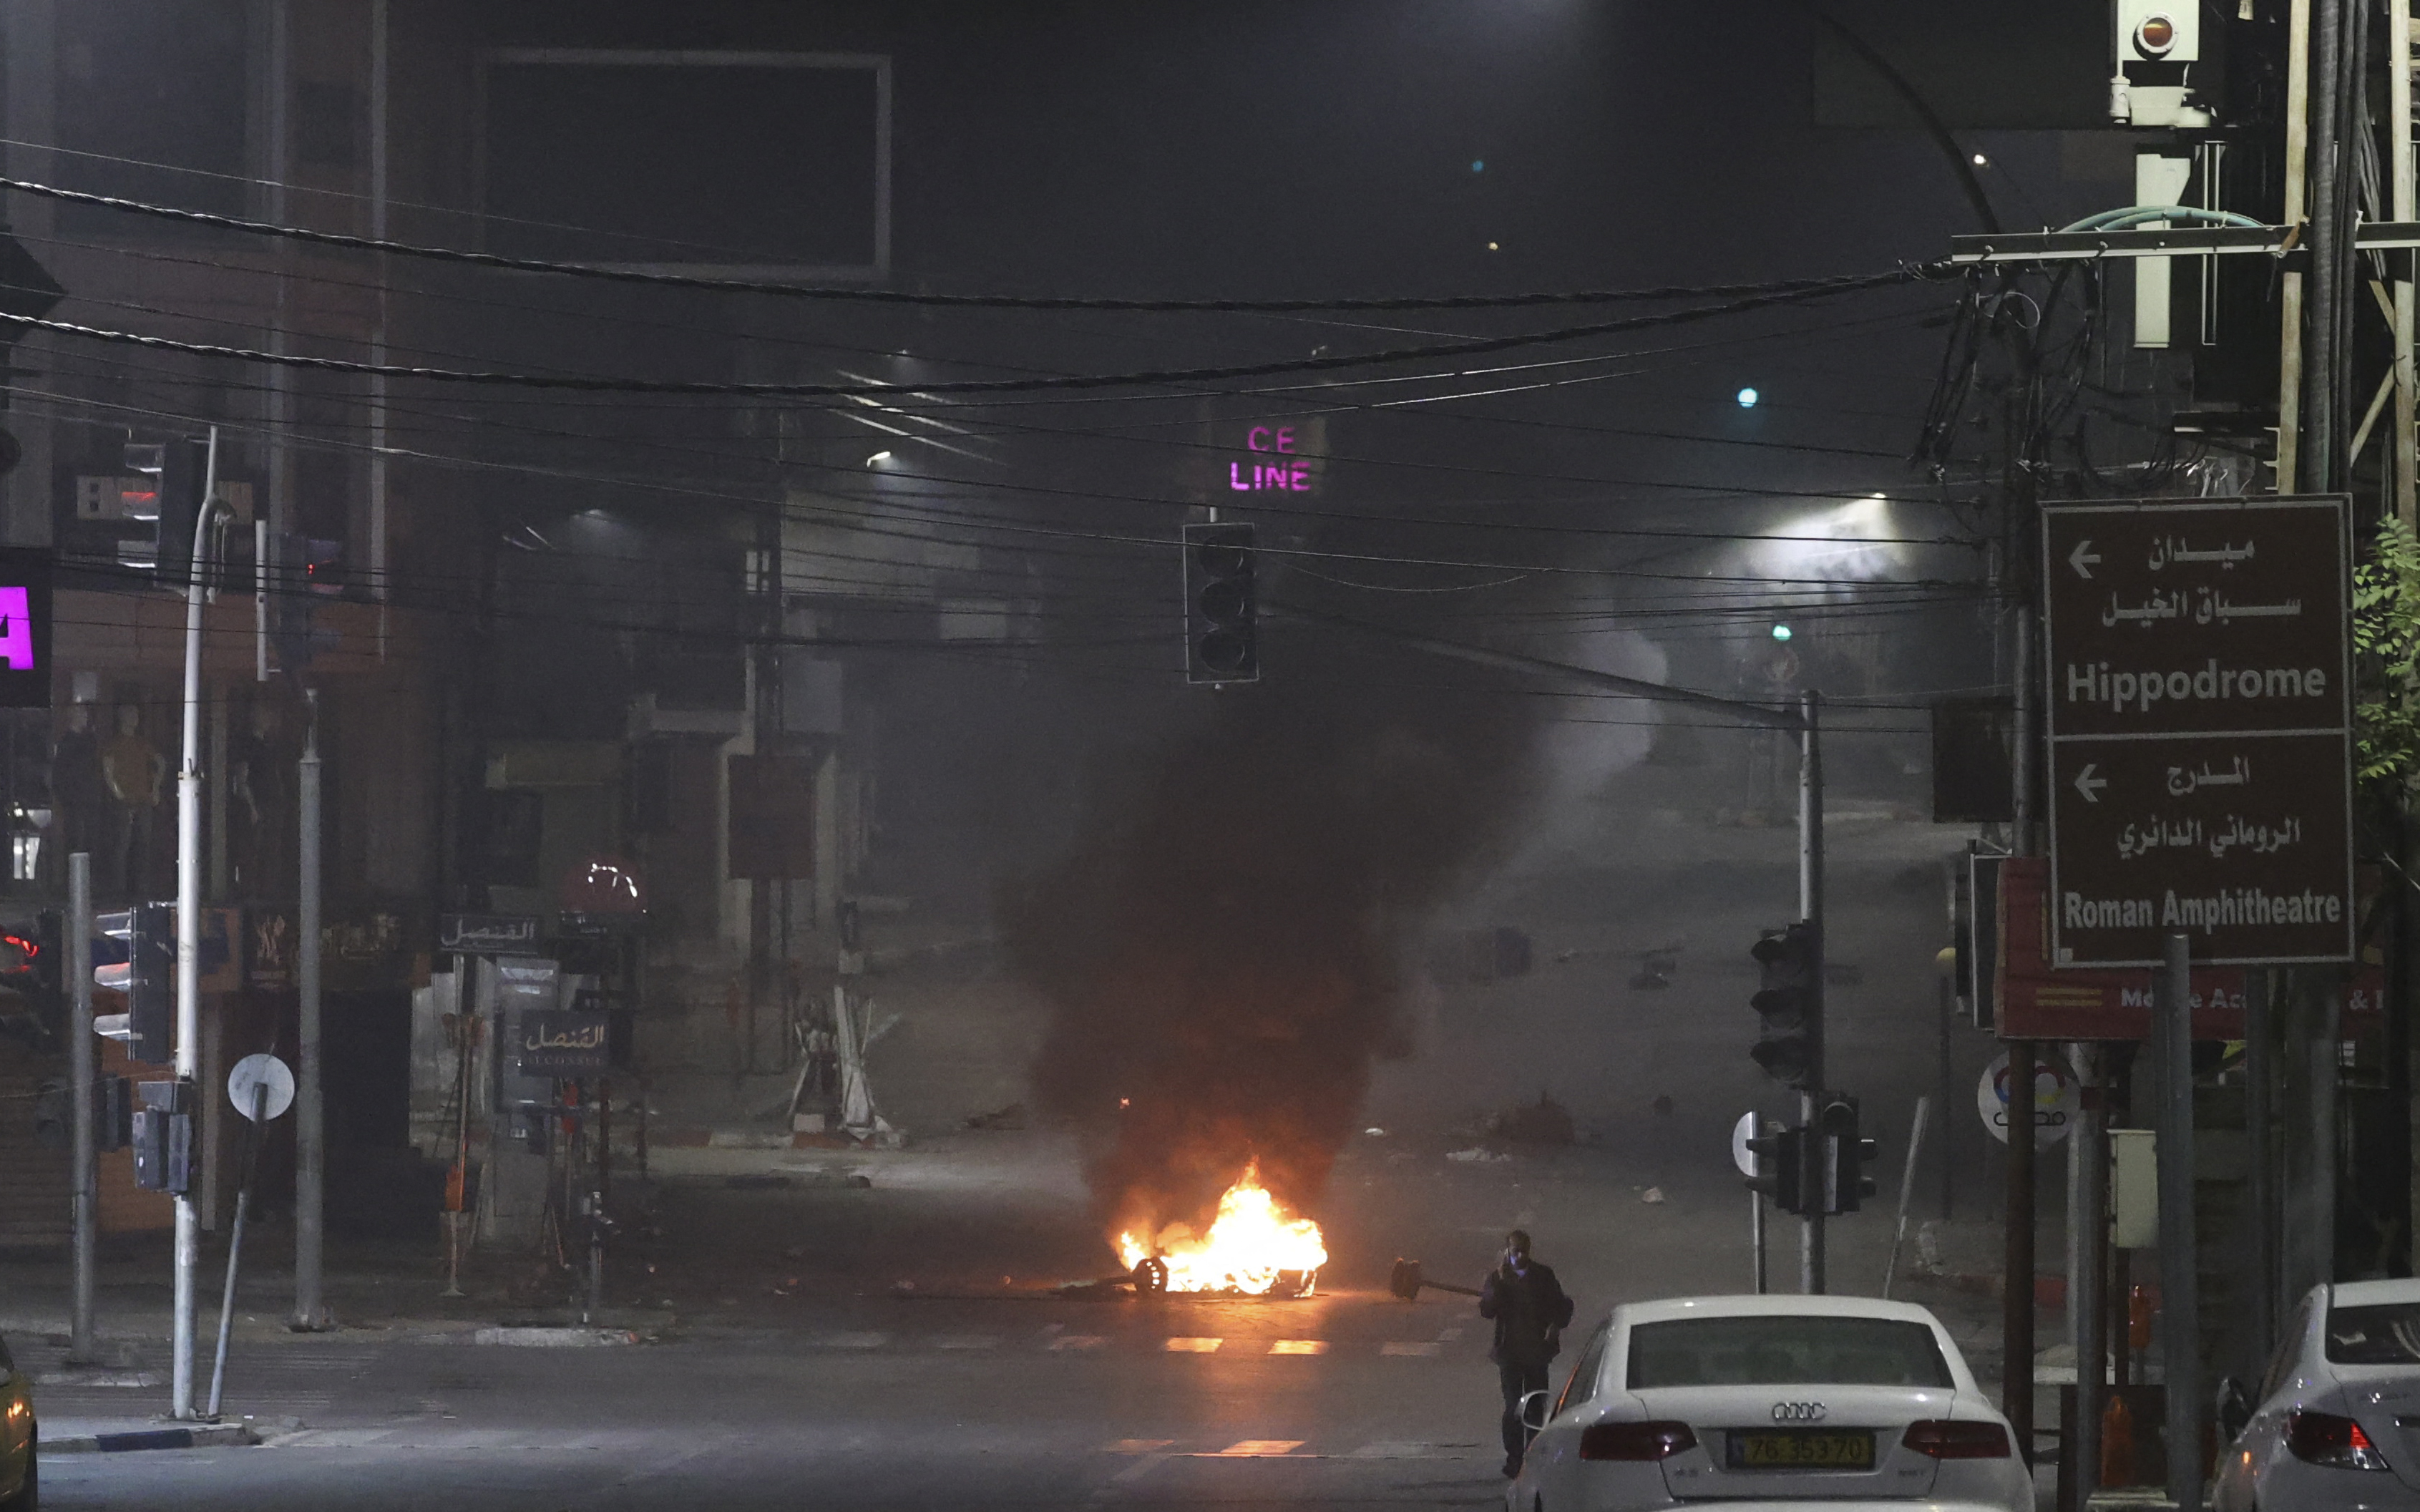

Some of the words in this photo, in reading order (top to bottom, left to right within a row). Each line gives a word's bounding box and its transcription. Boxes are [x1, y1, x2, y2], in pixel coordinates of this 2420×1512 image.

[1247, 426, 1296, 455] CE
[1230, 462, 1312, 492] LINE
[2149, 534, 2255, 571] ميدان
[2102, 585, 2188, 628] الخيل
[2196, 585, 2302, 625] سباق
[2067, 658, 2326, 713] Hippodrome
[2117, 814, 2202, 859] الدائري
[2210, 814, 2301, 858] الروماني
[2064, 891, 2153, 929] Roman
[2161, 887, 2341, 935] Amphitheatre
[2348, 989, 2368, 1010] &
[526, 1023, 605, 1051] القنصل
